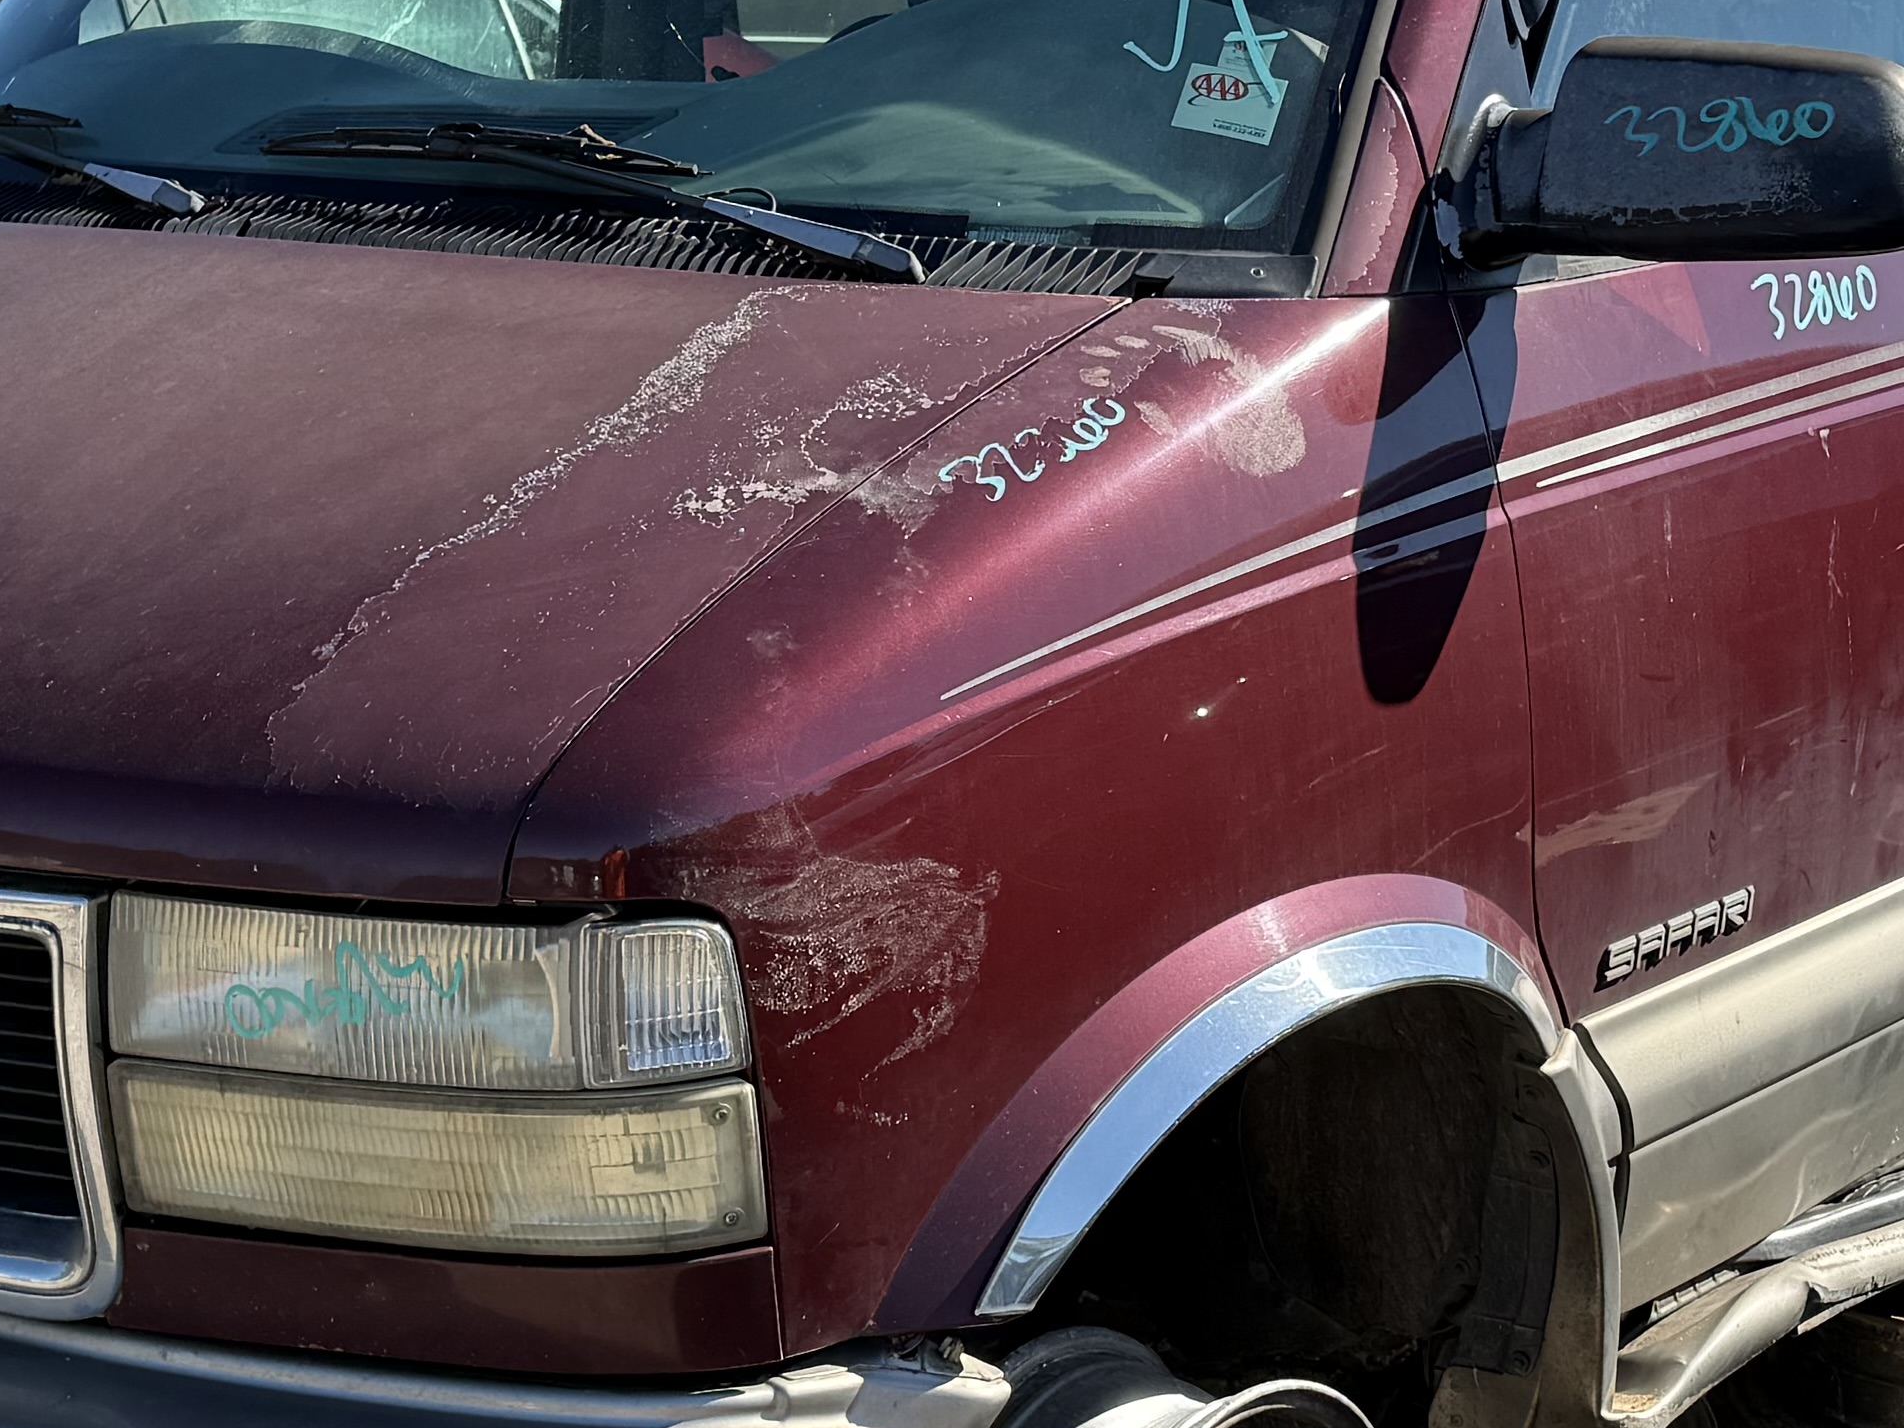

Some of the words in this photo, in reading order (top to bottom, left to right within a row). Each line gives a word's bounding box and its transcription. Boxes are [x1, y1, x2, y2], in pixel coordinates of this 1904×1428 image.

[1196, 74, 1242, 101] AAA
[1604, 97, 1835, 157] 32860
[1750, 265, 1878, 340] 32860
[1600, 884, 1756, 984] SAFARI
